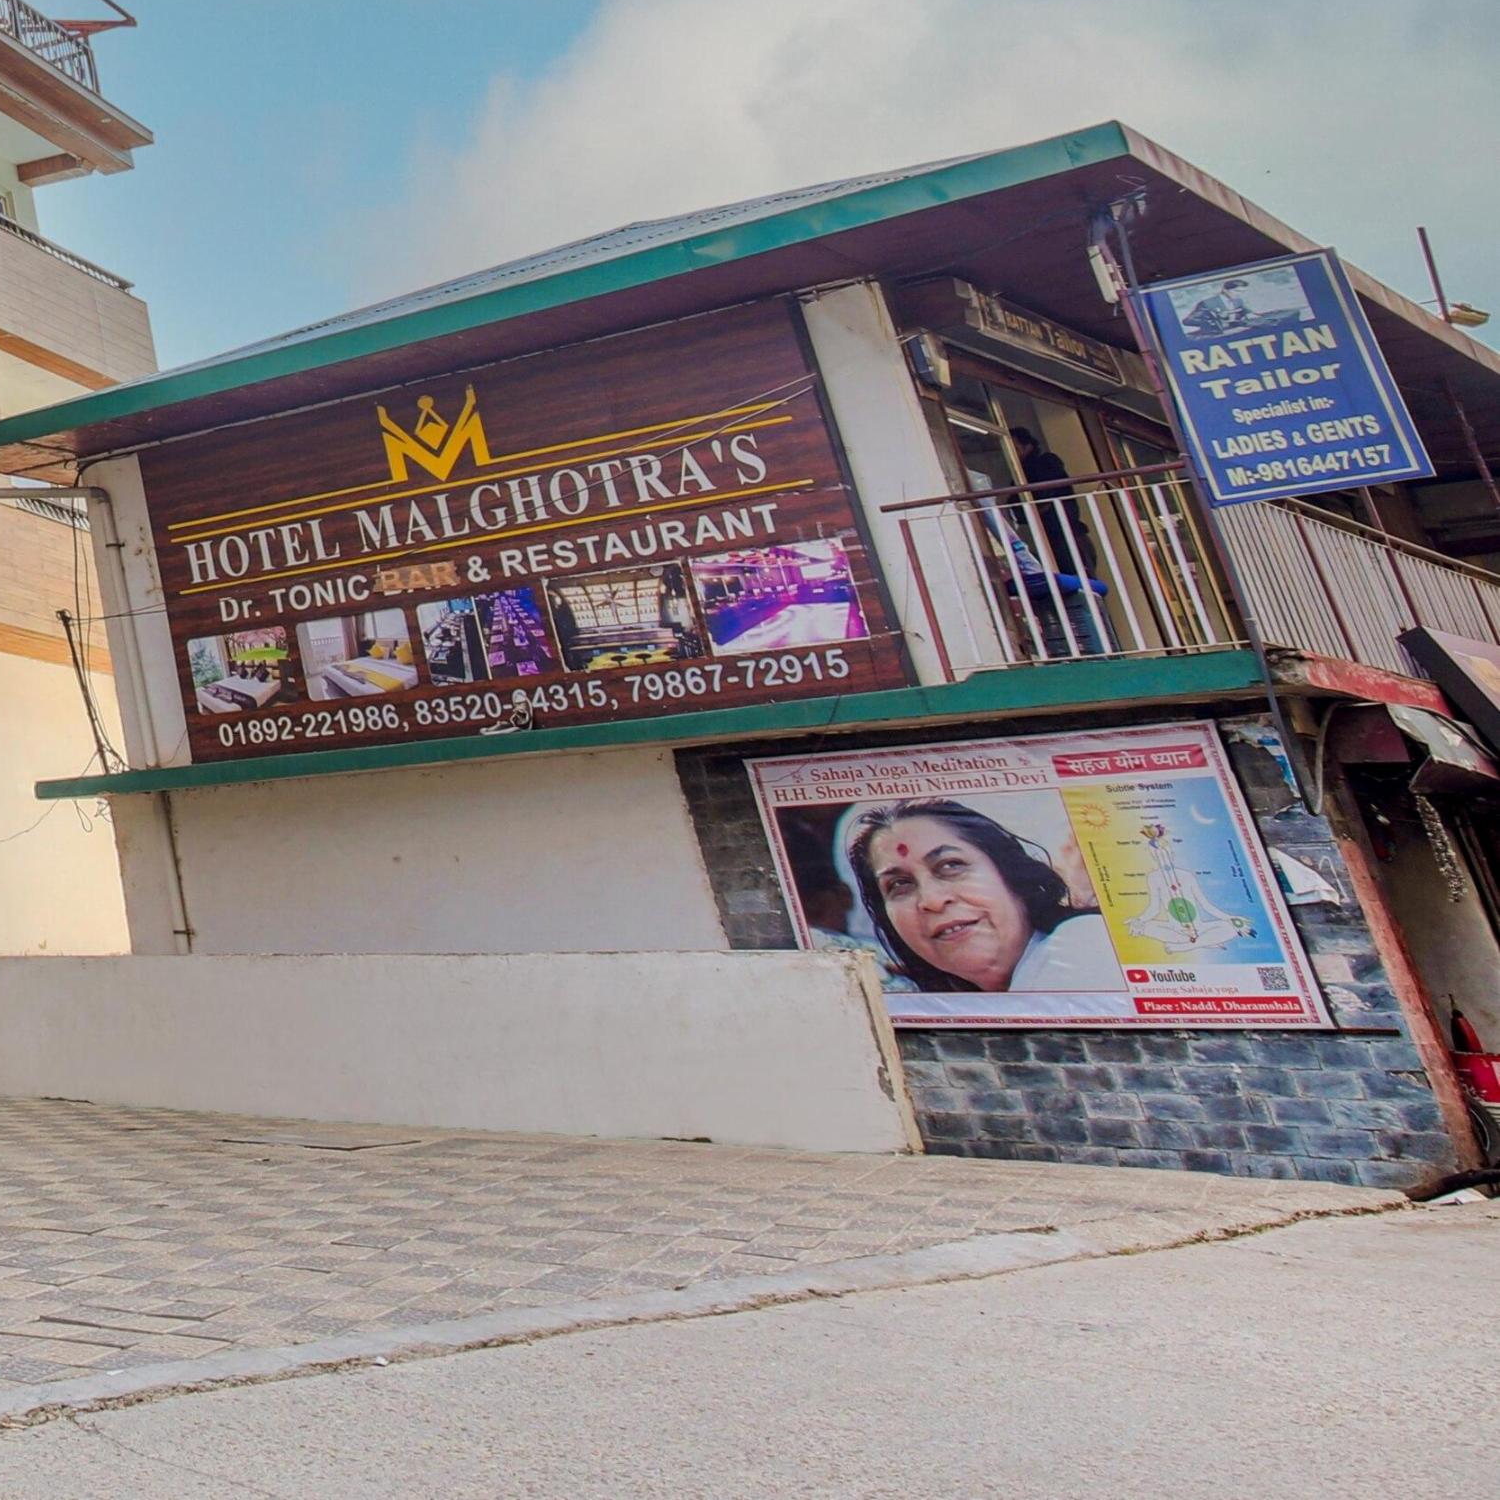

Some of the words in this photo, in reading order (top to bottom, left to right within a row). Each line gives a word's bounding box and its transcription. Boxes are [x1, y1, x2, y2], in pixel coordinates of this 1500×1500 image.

[1179, 325, 1338, 375] RATTAN
[1200, 363, 1341, 400] Tailor
[1233, 399, 1308, 425] Specialist
[1212, 429, 1288, 459] LADIES
[1293, 431, 1306, 447] &
[1307, 414, 1381, 443] GENTS
[1225, 444, 1392, 488] M:-9816447157
[184, 519, 341, 585] HOTEL
[352, 433, 767, 553] MALGHOTRA'S
[219, 596, 261, 622] Dr.
[269, 574, 370, 613] TONIC
[467, 555, 491, 583] &
[500, 503, 778, 578] RESTAURANT
[219, 703, 410, 747] 01892-221986,
[624, 648, 849, 703] 79867-72915
[810, 765, 864, 782] Sahaja
[867, 763, 908, 781] Yoga
[912, 755, 1008, 774] Meditation
[1067, 757, 1111, 774] सहज
[1112, 751, 1147, 769] योग
[1151, 751, 1192, 766] ध्यान
[773, 786, 813, 803] H.H.
[815, 783, 862, 801] Shree
[867, 778, 922, 796] Mataji
[926, 774, 1000, 792] Nirmala
[1005, 769, 1049, 786] Devi
[1135, 985, 1178, 995] Learning
[1181, 985, 1213, 994] Sahaja
[1215, 987, 1239, 995] yoga
[1150, 970, 1196, 983] YouTube
[1143, 1001, 1173, 1012] Place
[1181, 1001, 1221, 1013] Naddi,
[1222, 1001, 1300, 1012] Dharamshala
